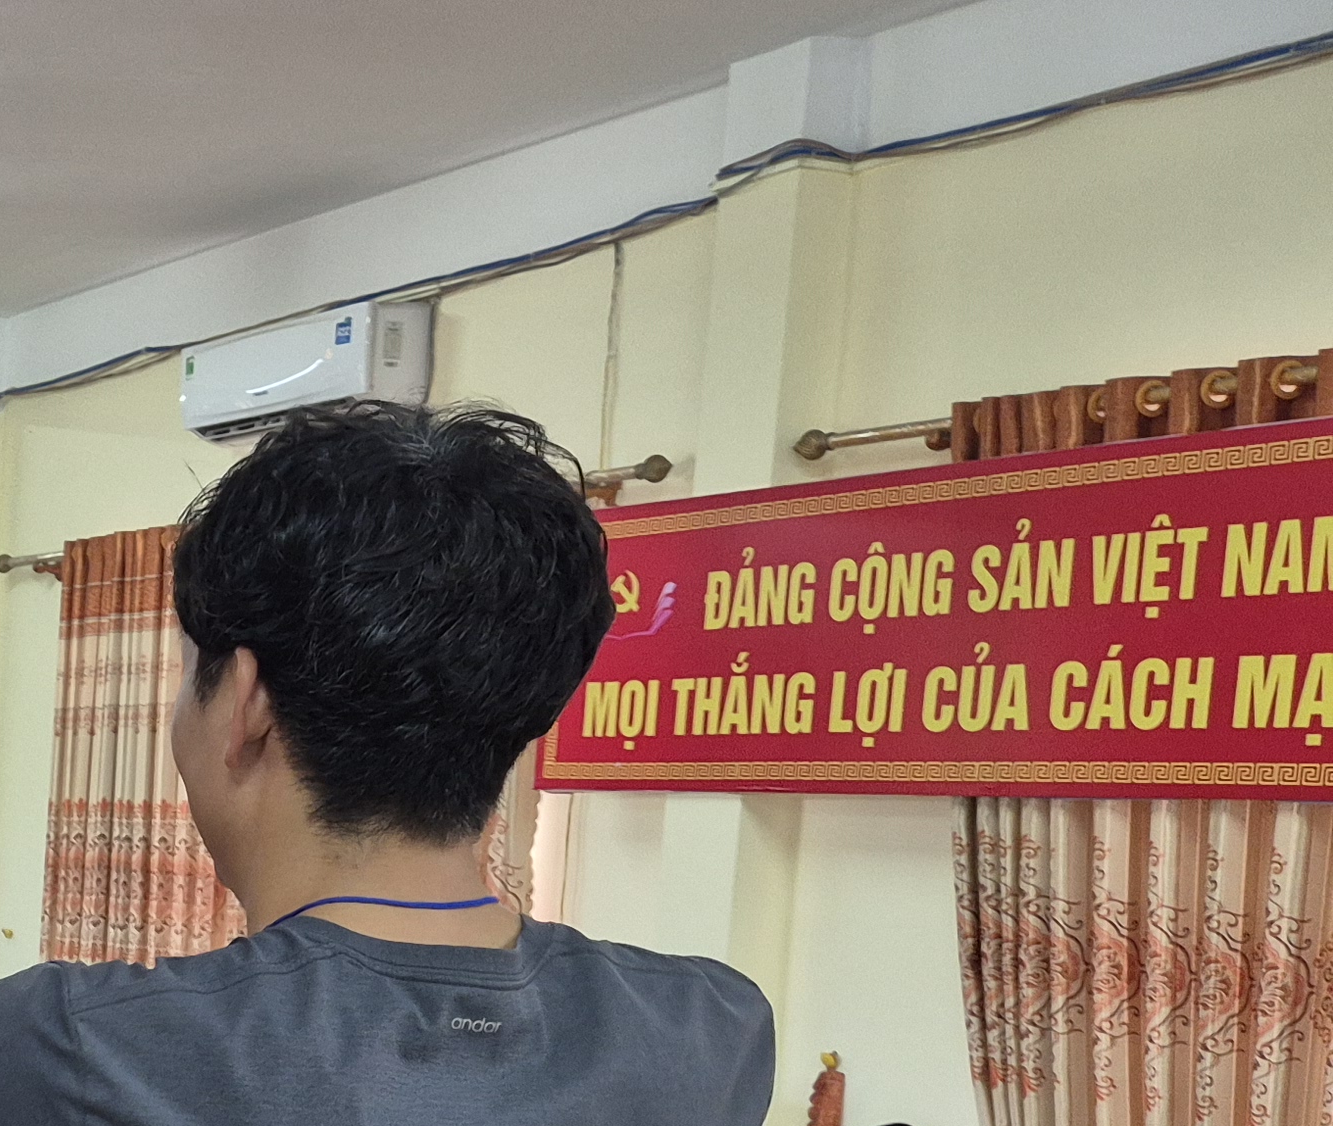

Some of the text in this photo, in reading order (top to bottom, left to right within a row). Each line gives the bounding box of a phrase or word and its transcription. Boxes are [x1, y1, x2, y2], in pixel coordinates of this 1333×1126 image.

[703, 546, 817, 631] ĐẢNG
[828, 541, 955, 635] CỘNG
[967, 518, 1076, 614] SẢN
[1091, 513, 1209, 619] VIỆT
[582, 679, 661, 751] MỌI
[671, 651, 816, 736] THẮNG
[827, 662, 909, 748] LỢI
[921, 641, 1030, 733] CỦA
[1049, 643, 1215, 731] CÁCH
[450, 1016, 503, 1033] andar
